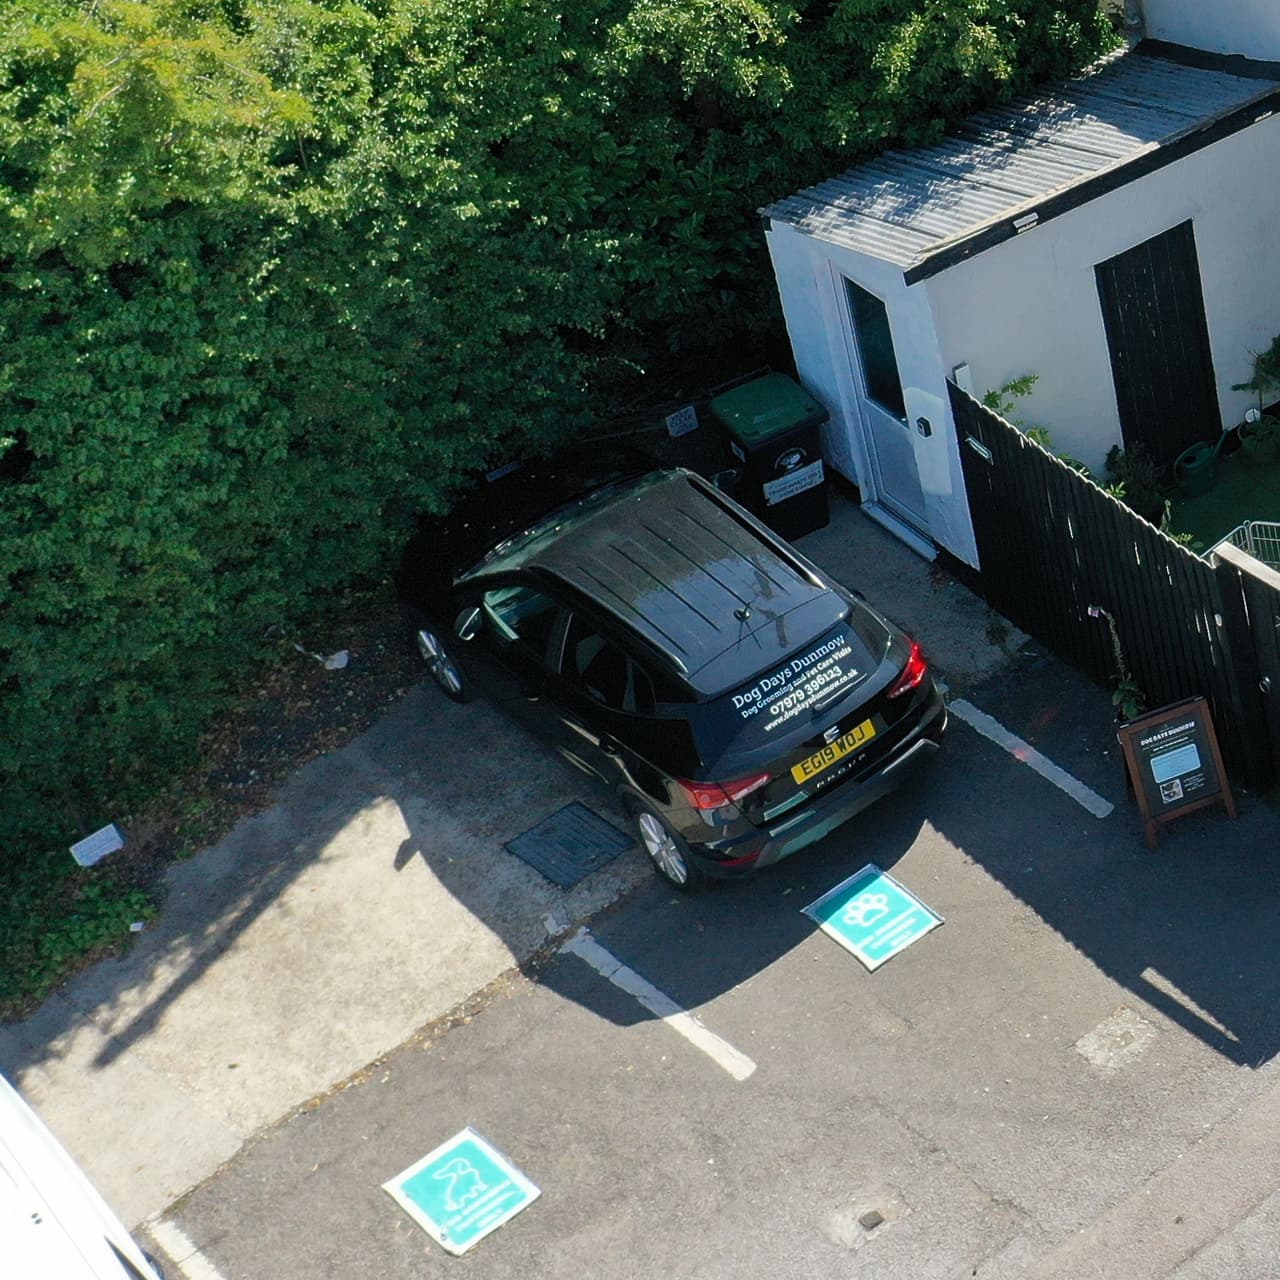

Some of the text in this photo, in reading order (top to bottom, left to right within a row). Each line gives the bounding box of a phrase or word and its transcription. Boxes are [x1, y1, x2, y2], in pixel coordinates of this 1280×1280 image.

[731, 634, 845, 709] Dog Days Dunmow
[769, 665, 843, 715] 07979 396123
[741, 705, 759, 719] Dog
[756, 683, 794, 709] Grooming
[763, 667, 859, 732] www.dogdaysdunmow.co.uk
[800, 726, 866, 775] EG19 WOJ
